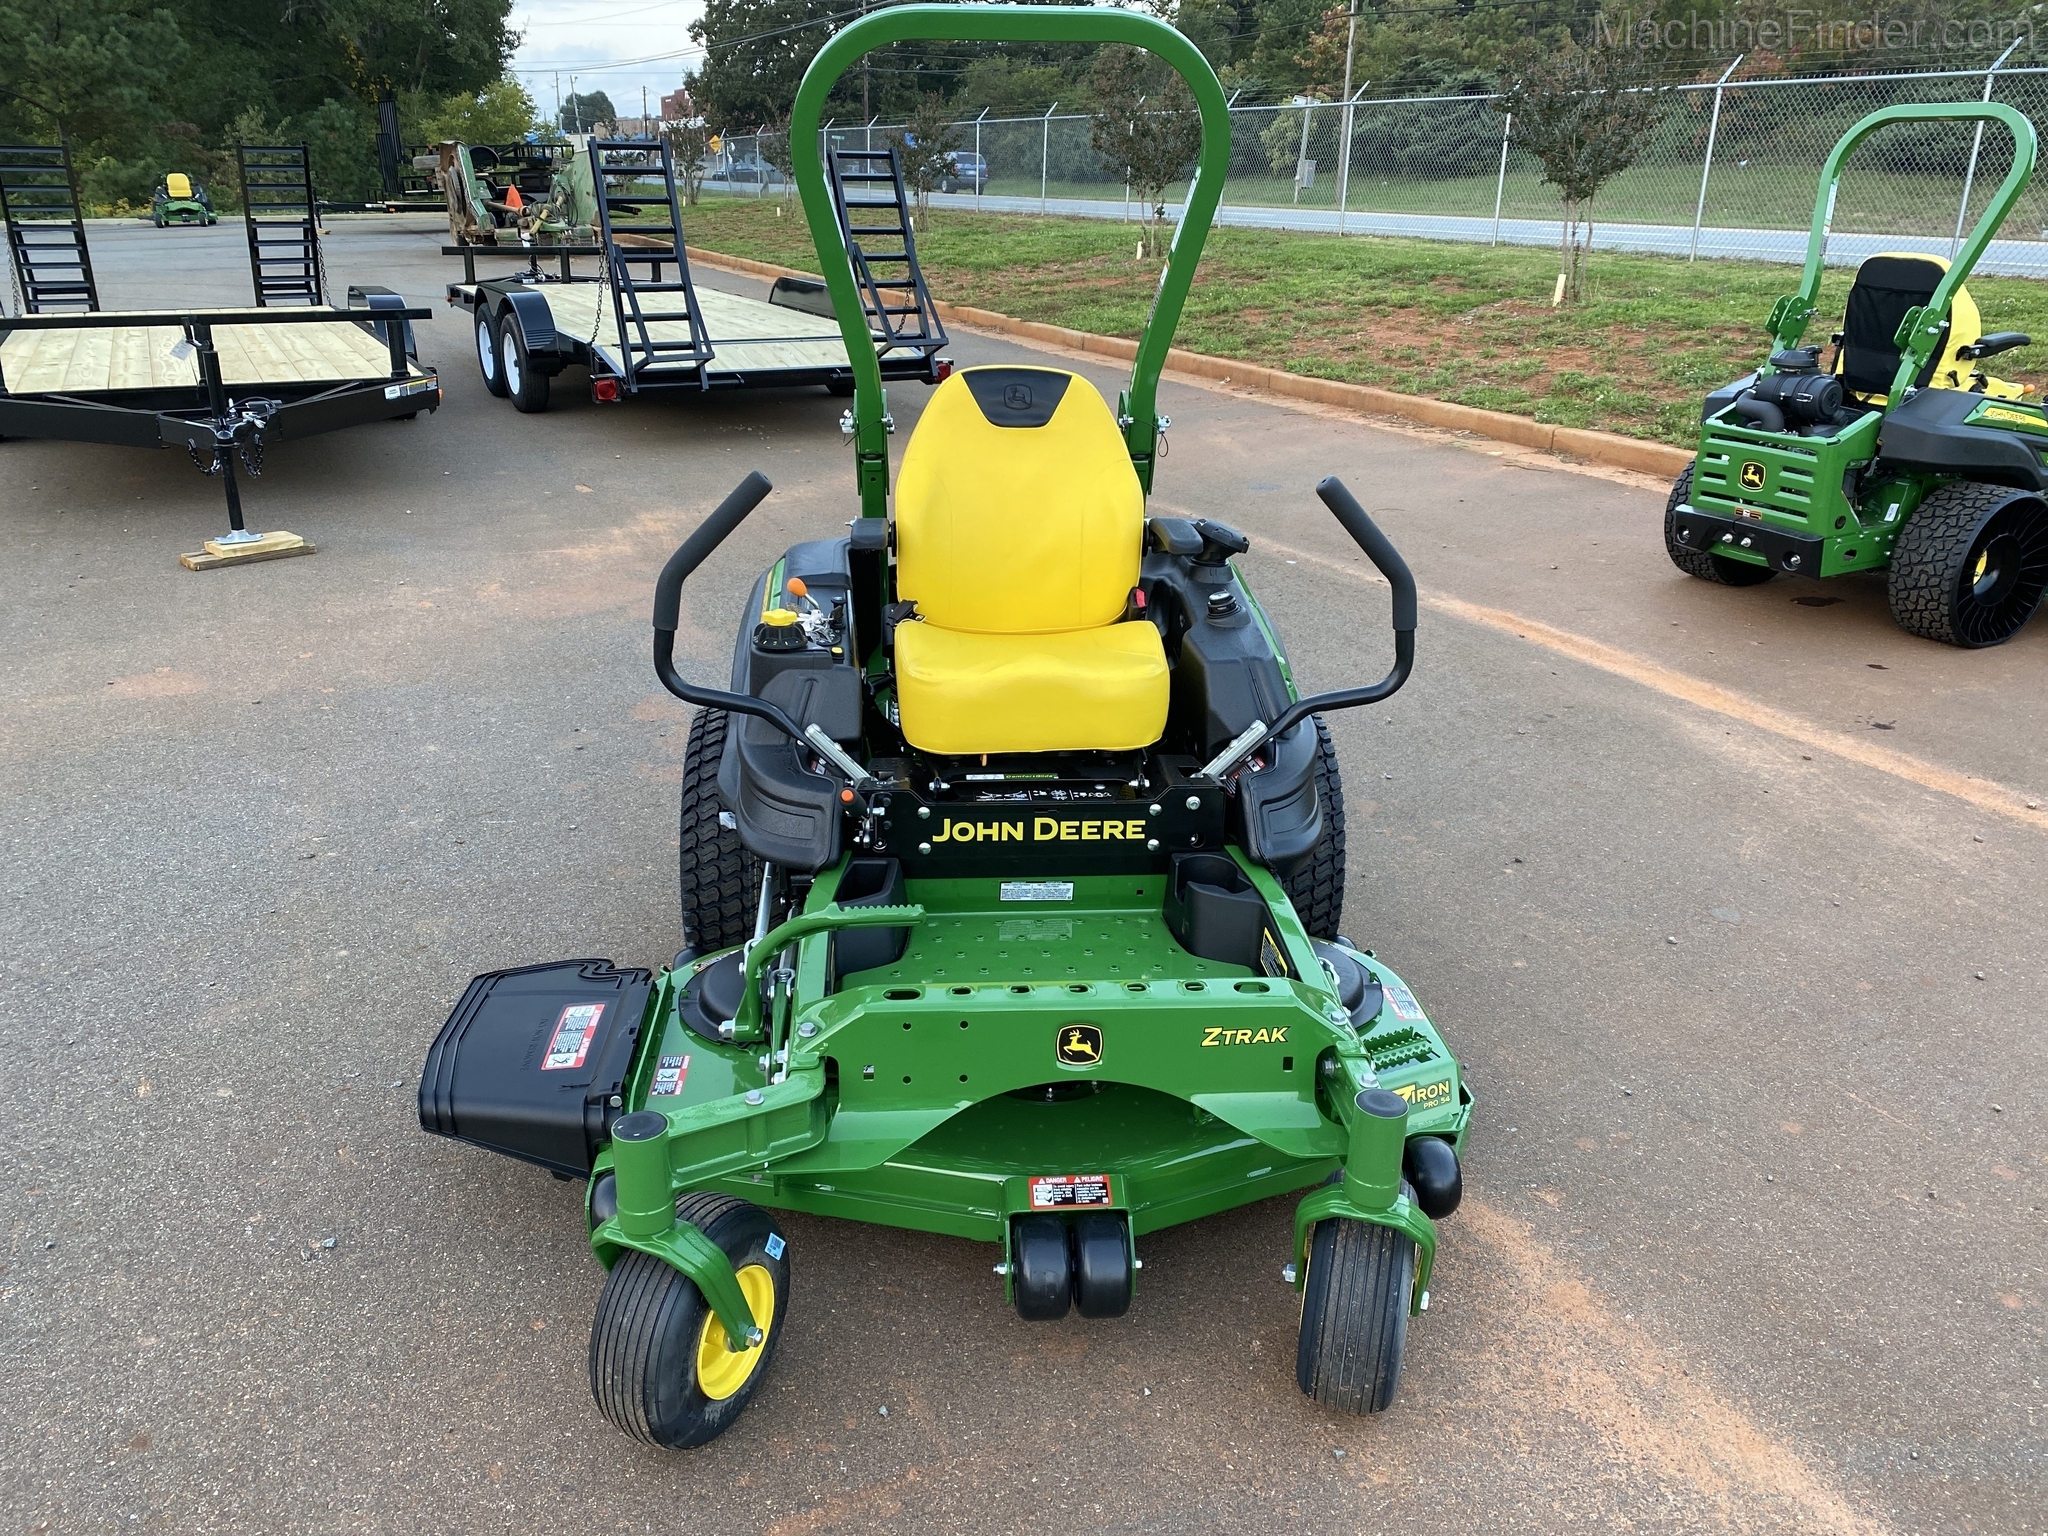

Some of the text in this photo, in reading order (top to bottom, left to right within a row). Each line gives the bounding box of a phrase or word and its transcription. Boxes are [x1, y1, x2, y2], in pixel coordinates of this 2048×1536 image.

[932, 817, 1146, 842] JOHN DEERE
[1201, 1026, 1289, 1047] ZTRAK
[1423, 1096, 1451, 1109] PRO 54
[1081, 1175, 1104, 1183] PELIGRO
